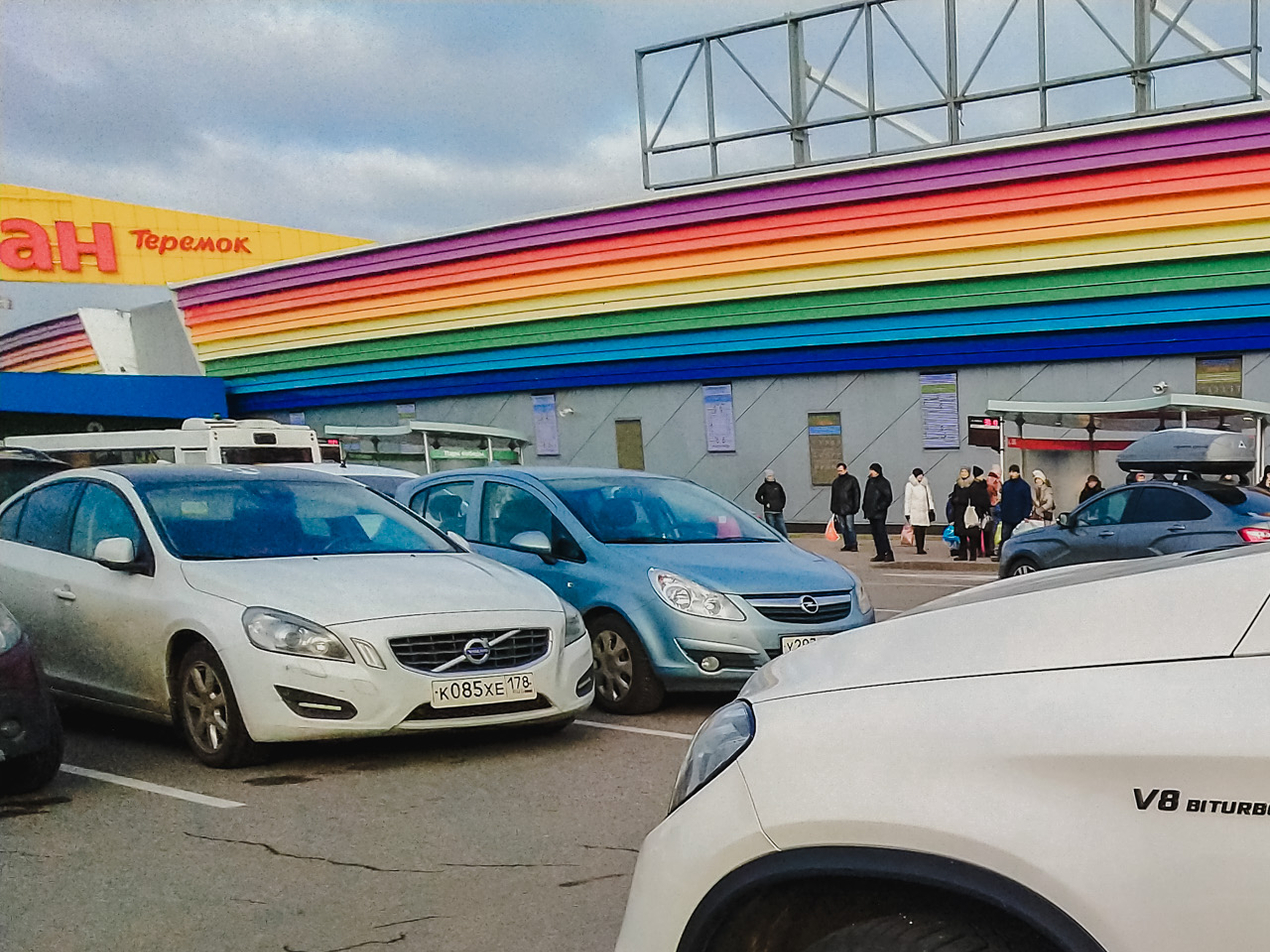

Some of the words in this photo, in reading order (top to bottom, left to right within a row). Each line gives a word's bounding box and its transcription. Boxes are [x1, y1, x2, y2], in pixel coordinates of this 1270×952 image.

[129, 229, 252, 255] Теремок
[507, 676, 530, 689] 178
[1133, 788, 1180, 811] V8
